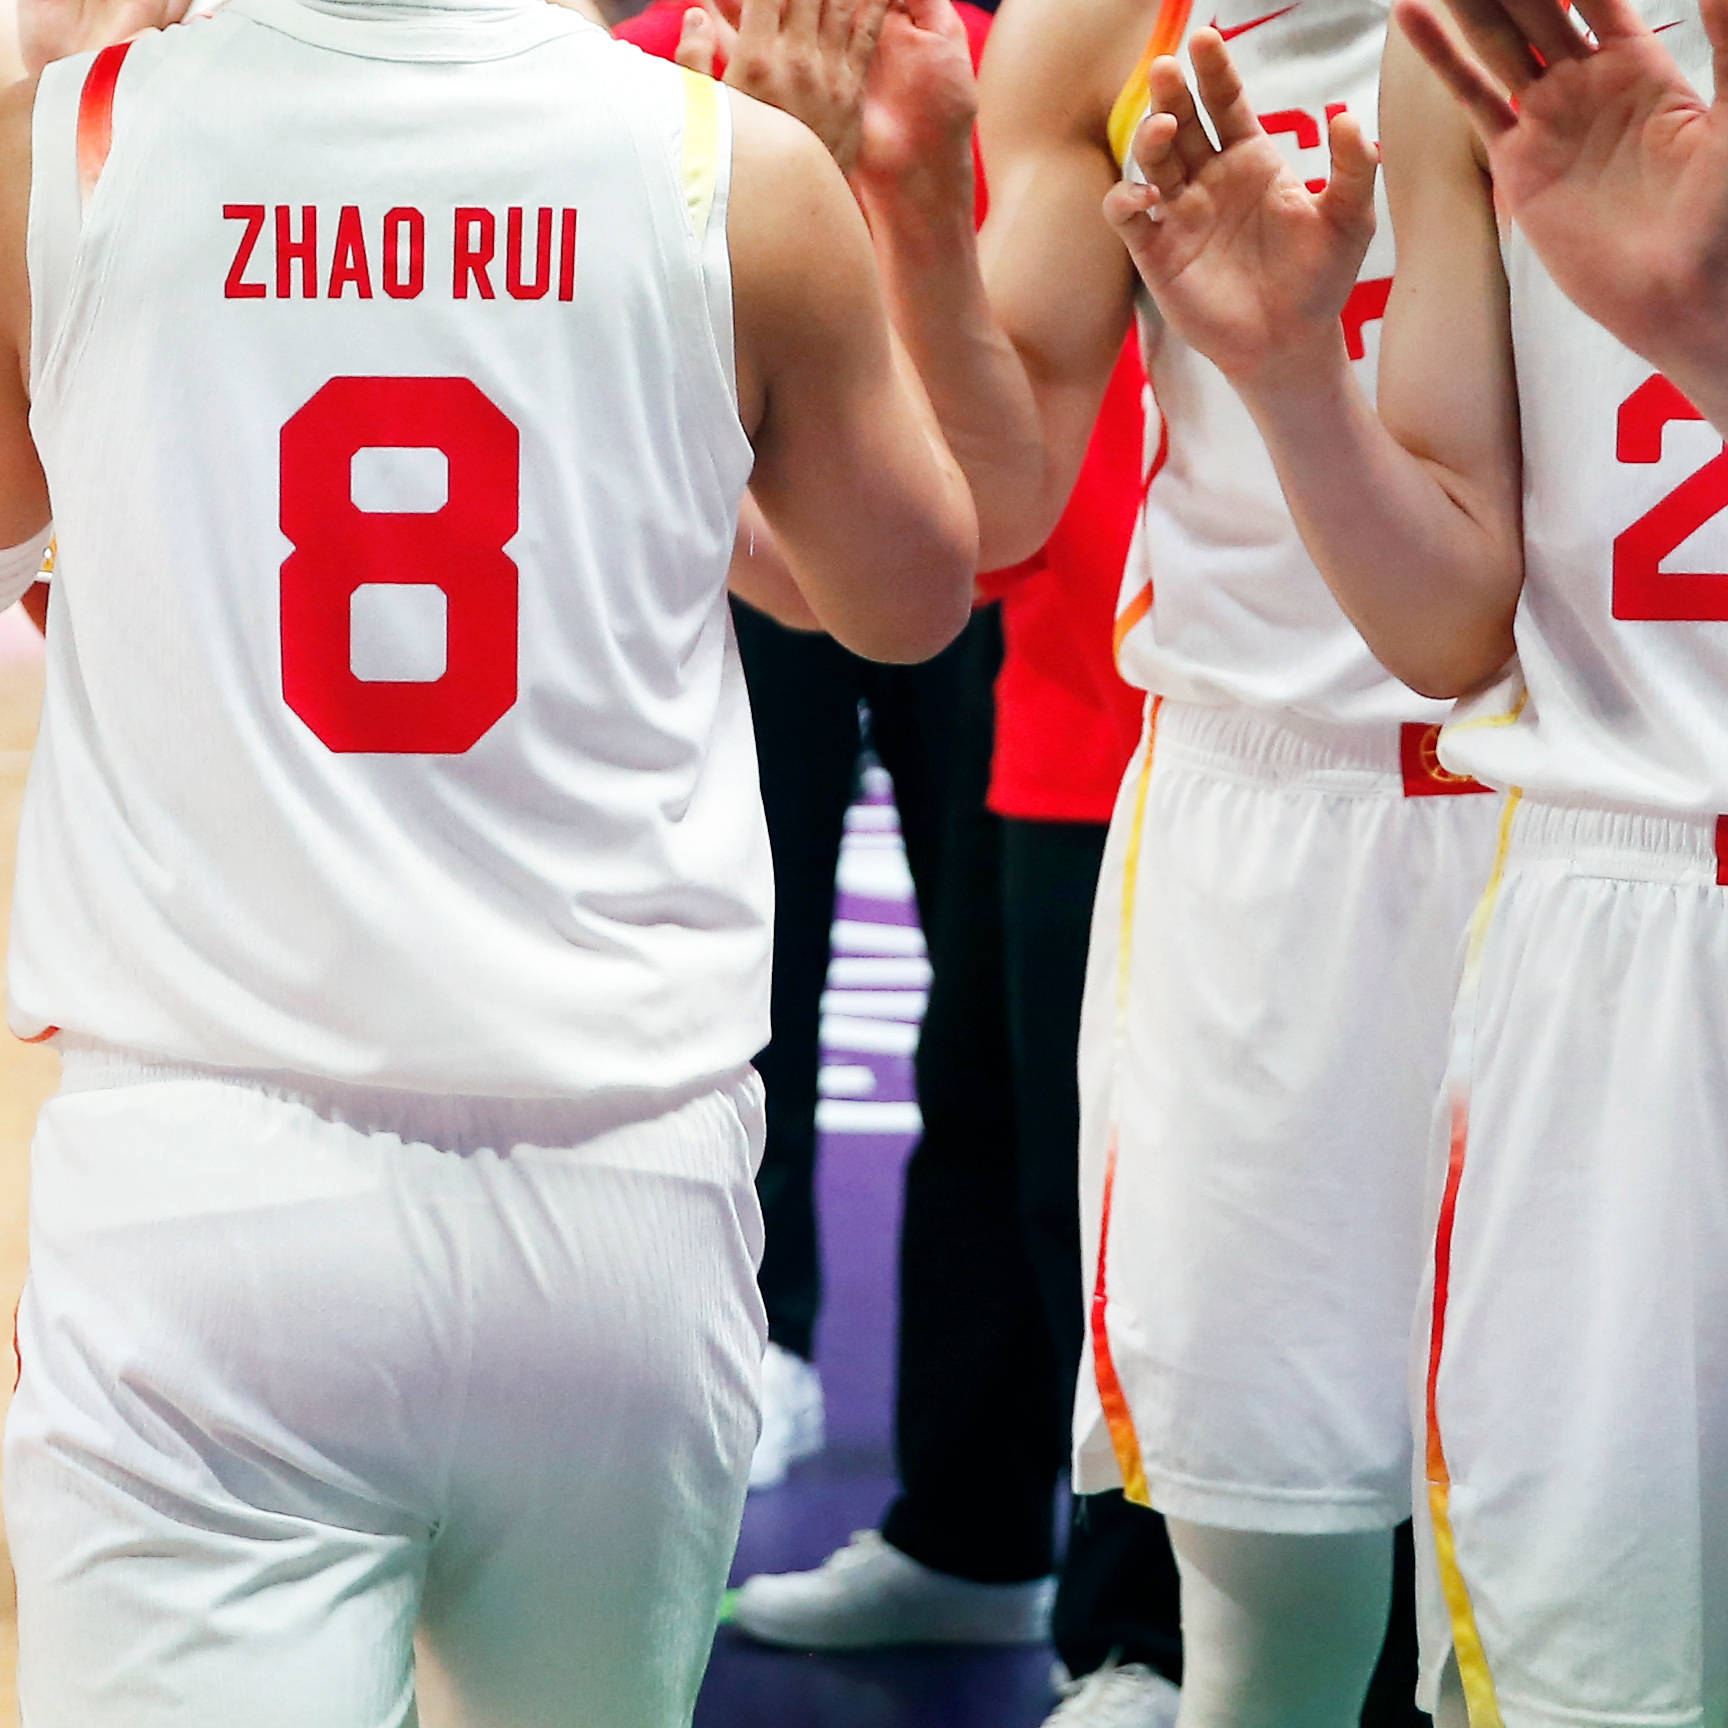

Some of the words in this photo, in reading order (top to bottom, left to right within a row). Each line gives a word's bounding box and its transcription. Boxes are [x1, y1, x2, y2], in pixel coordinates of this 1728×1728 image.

[222, 204, 425, 301] ZHAO
[453, 206, 577, 302] RUI
[279, 375, 521, 755] 8
